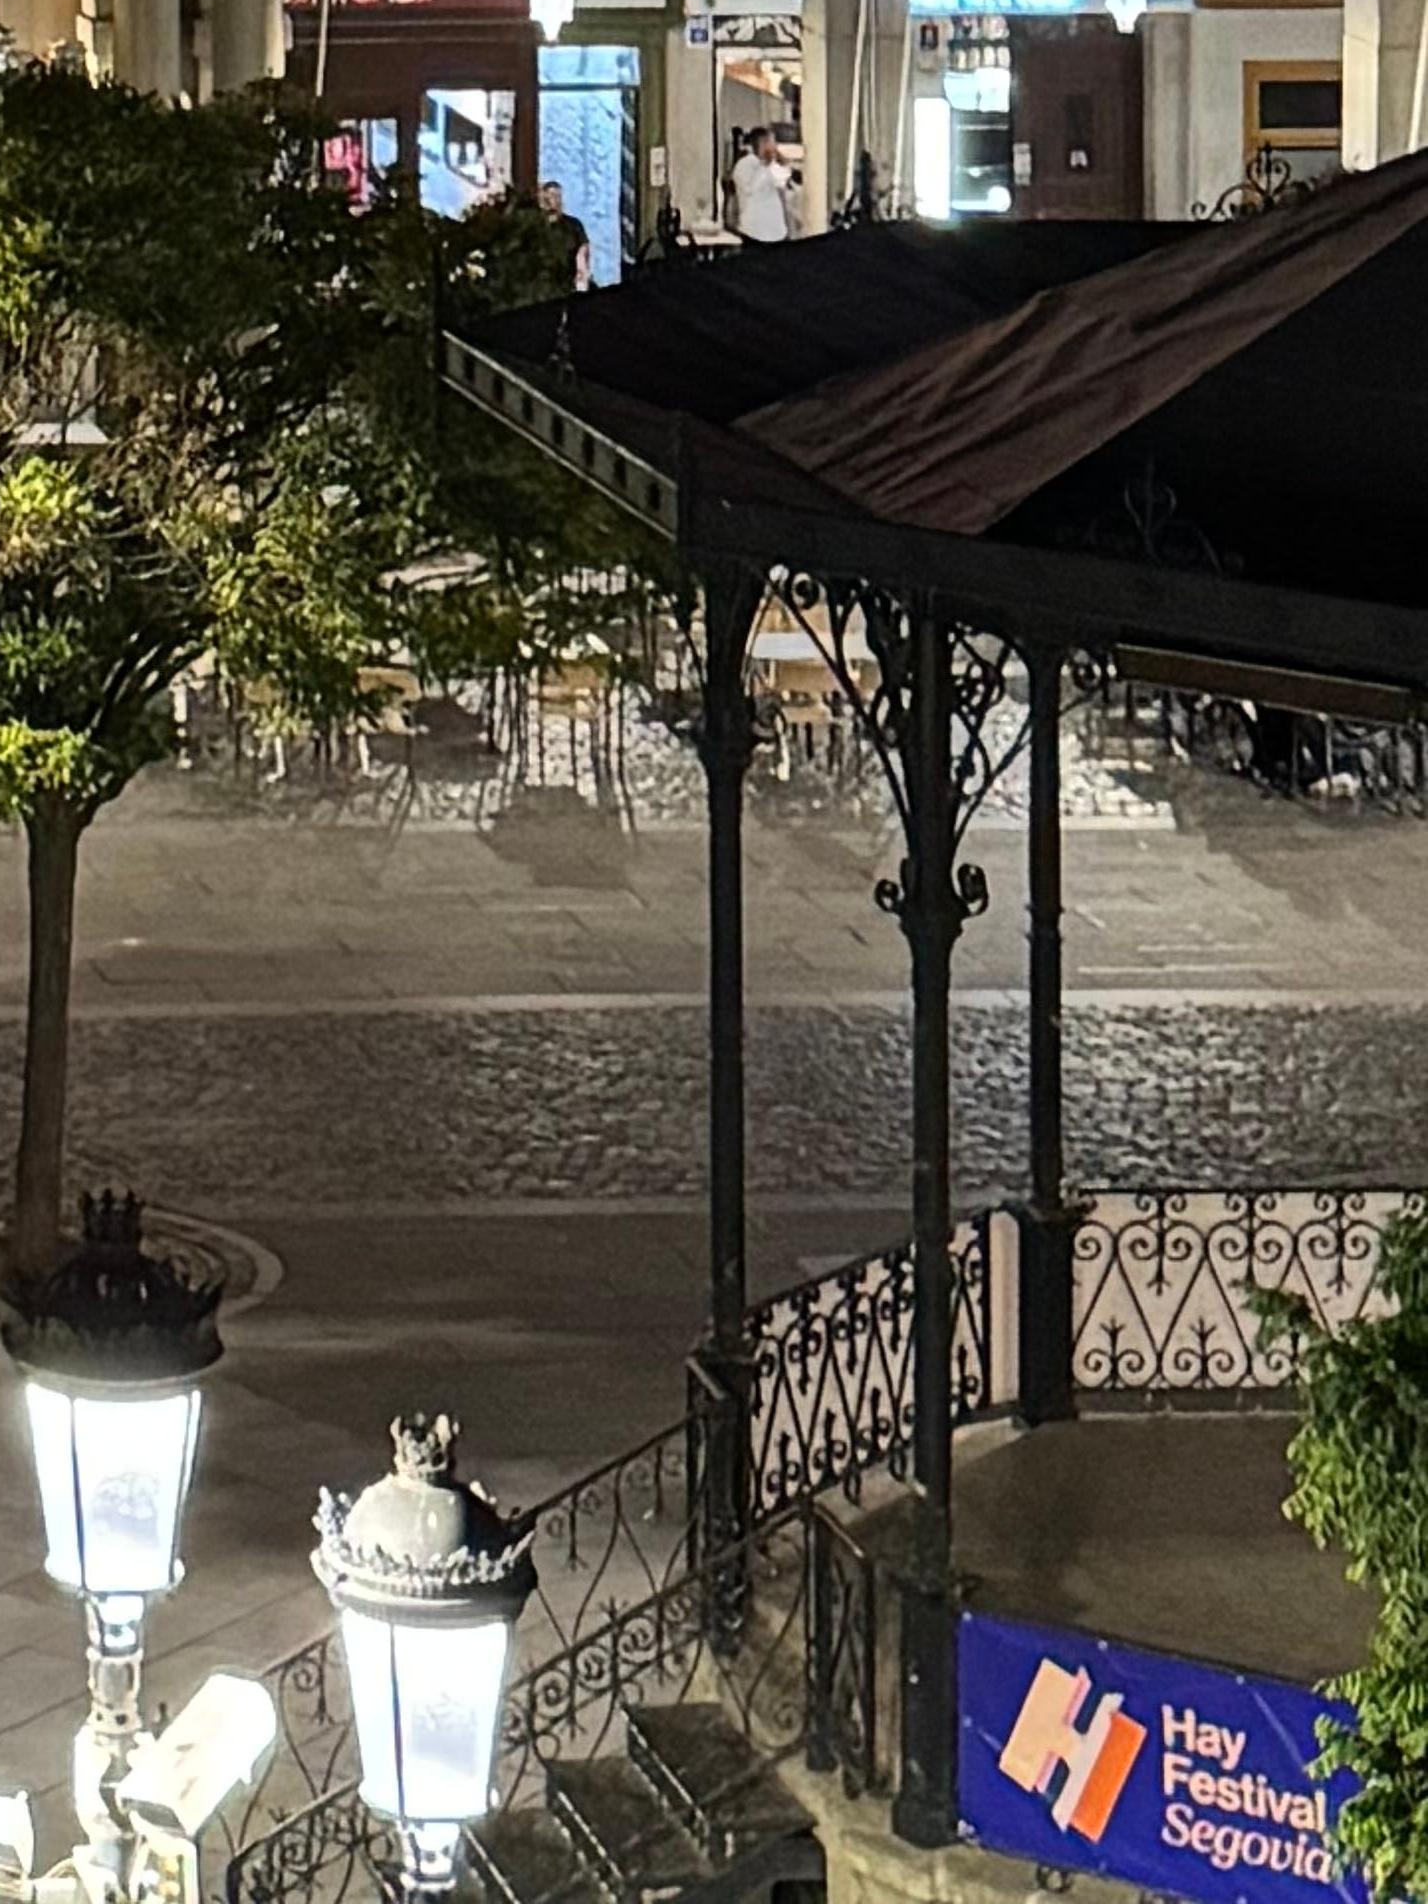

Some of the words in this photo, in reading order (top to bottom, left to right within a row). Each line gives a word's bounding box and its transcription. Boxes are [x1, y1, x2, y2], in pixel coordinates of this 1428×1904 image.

[1161, 1703, 1247, 1771] Hay
[1162, 1751, 1328, 1834] Festival
[1161, 1803, 1336, 1884] Segovia
